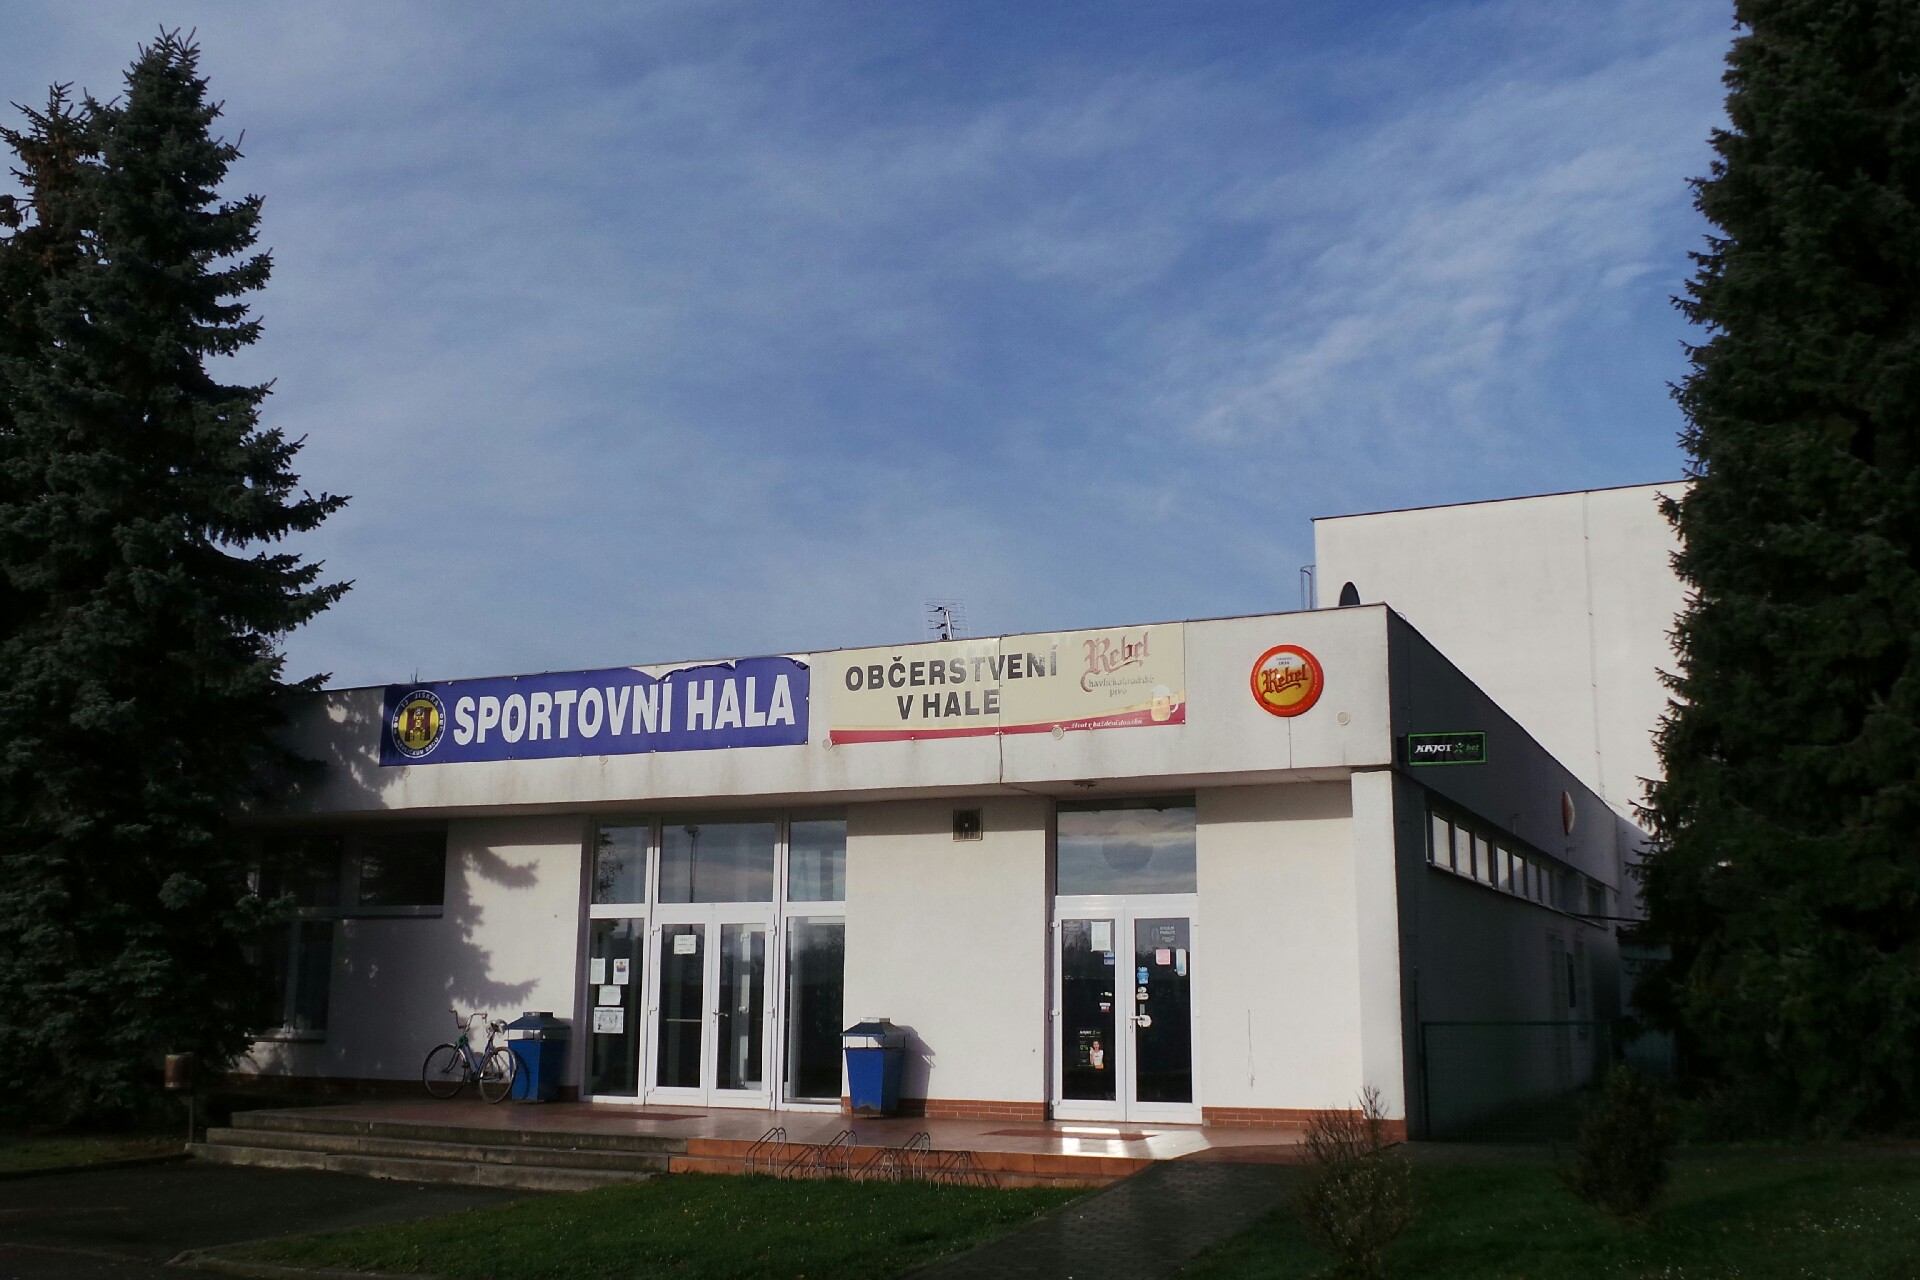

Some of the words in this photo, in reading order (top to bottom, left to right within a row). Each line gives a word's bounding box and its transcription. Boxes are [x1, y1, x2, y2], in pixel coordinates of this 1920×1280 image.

[845, 644, 1058, 692] OBČERSTVENÍ
[1081, 630, 1151, 685] Rebel
[1109, 689, 1127, 698] pivo
[1262, 662, 1309, 700] Rebel
[414, 692, 439, 707] JISKRA
[453, 675, 673, 746] SPORTOVNÍ
[686, 673, 795, 731] HALA
[896, 695, 914, 720] V
[922, 688, 1000, 719] HALE
[1414, 744, 1452, 754] KAJOT
[1465, 743, 1480, 752] bet
